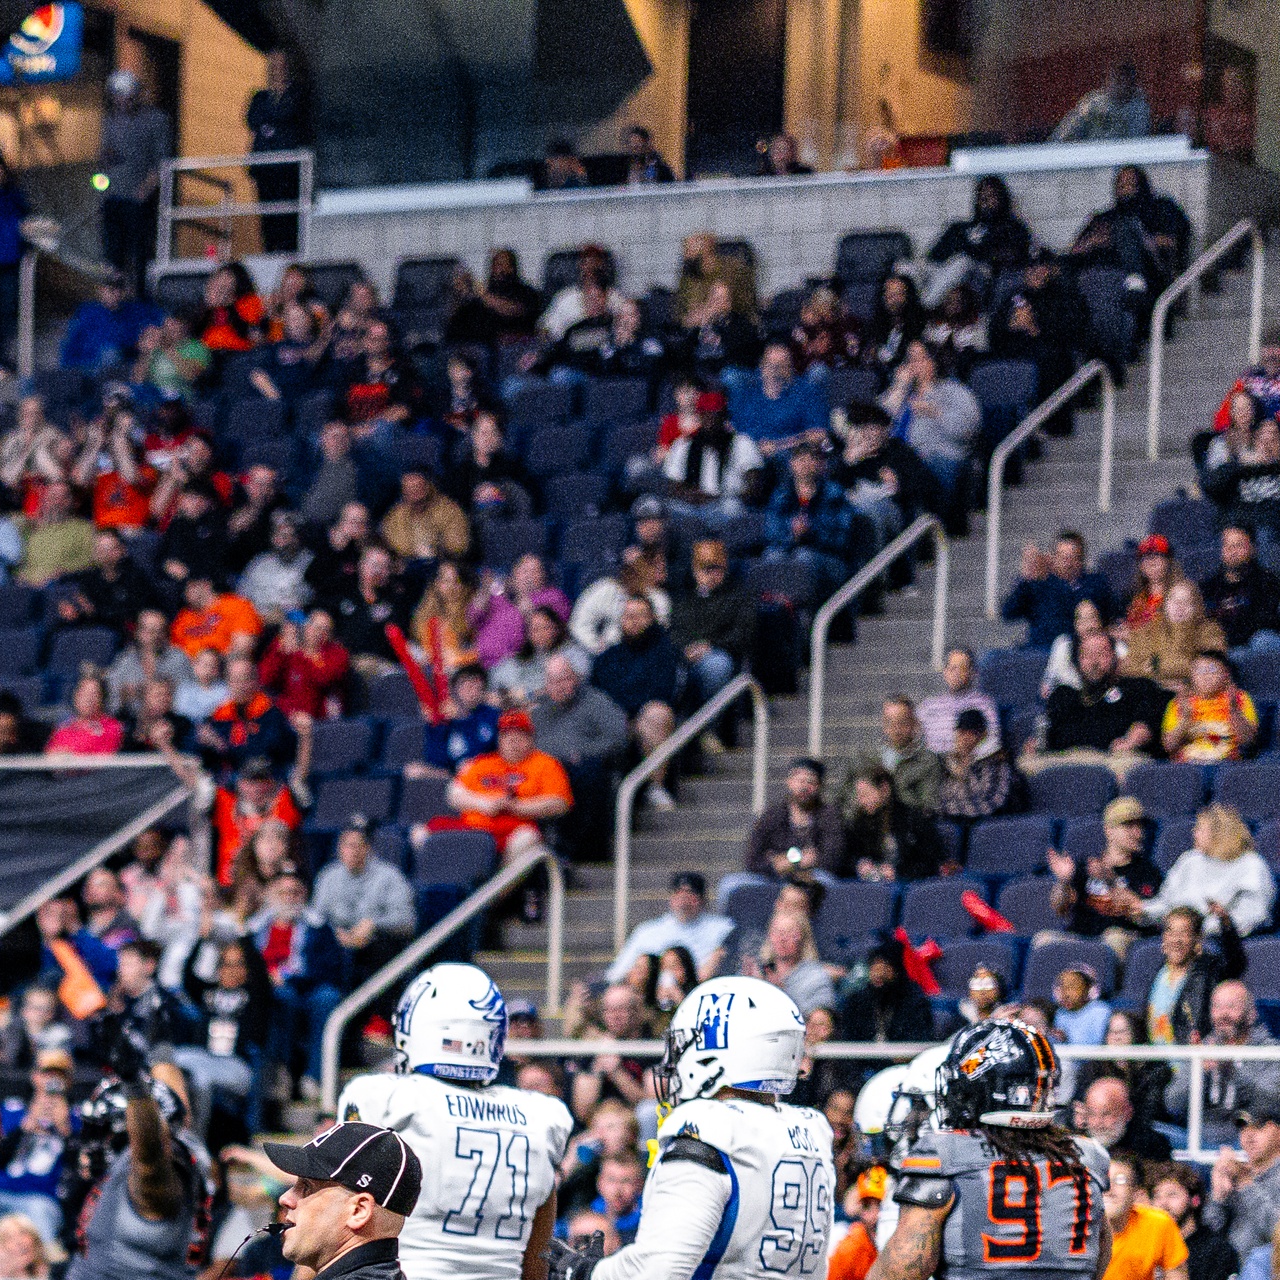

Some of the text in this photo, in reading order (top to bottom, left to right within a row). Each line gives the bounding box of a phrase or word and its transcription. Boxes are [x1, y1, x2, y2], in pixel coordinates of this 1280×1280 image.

[356, 1173, 373, 1188] S
[442, 1126, 530, 1241] 71
[758, 1159, 830, 1275] 99
[981, 1159, 1092, 1263] 97
